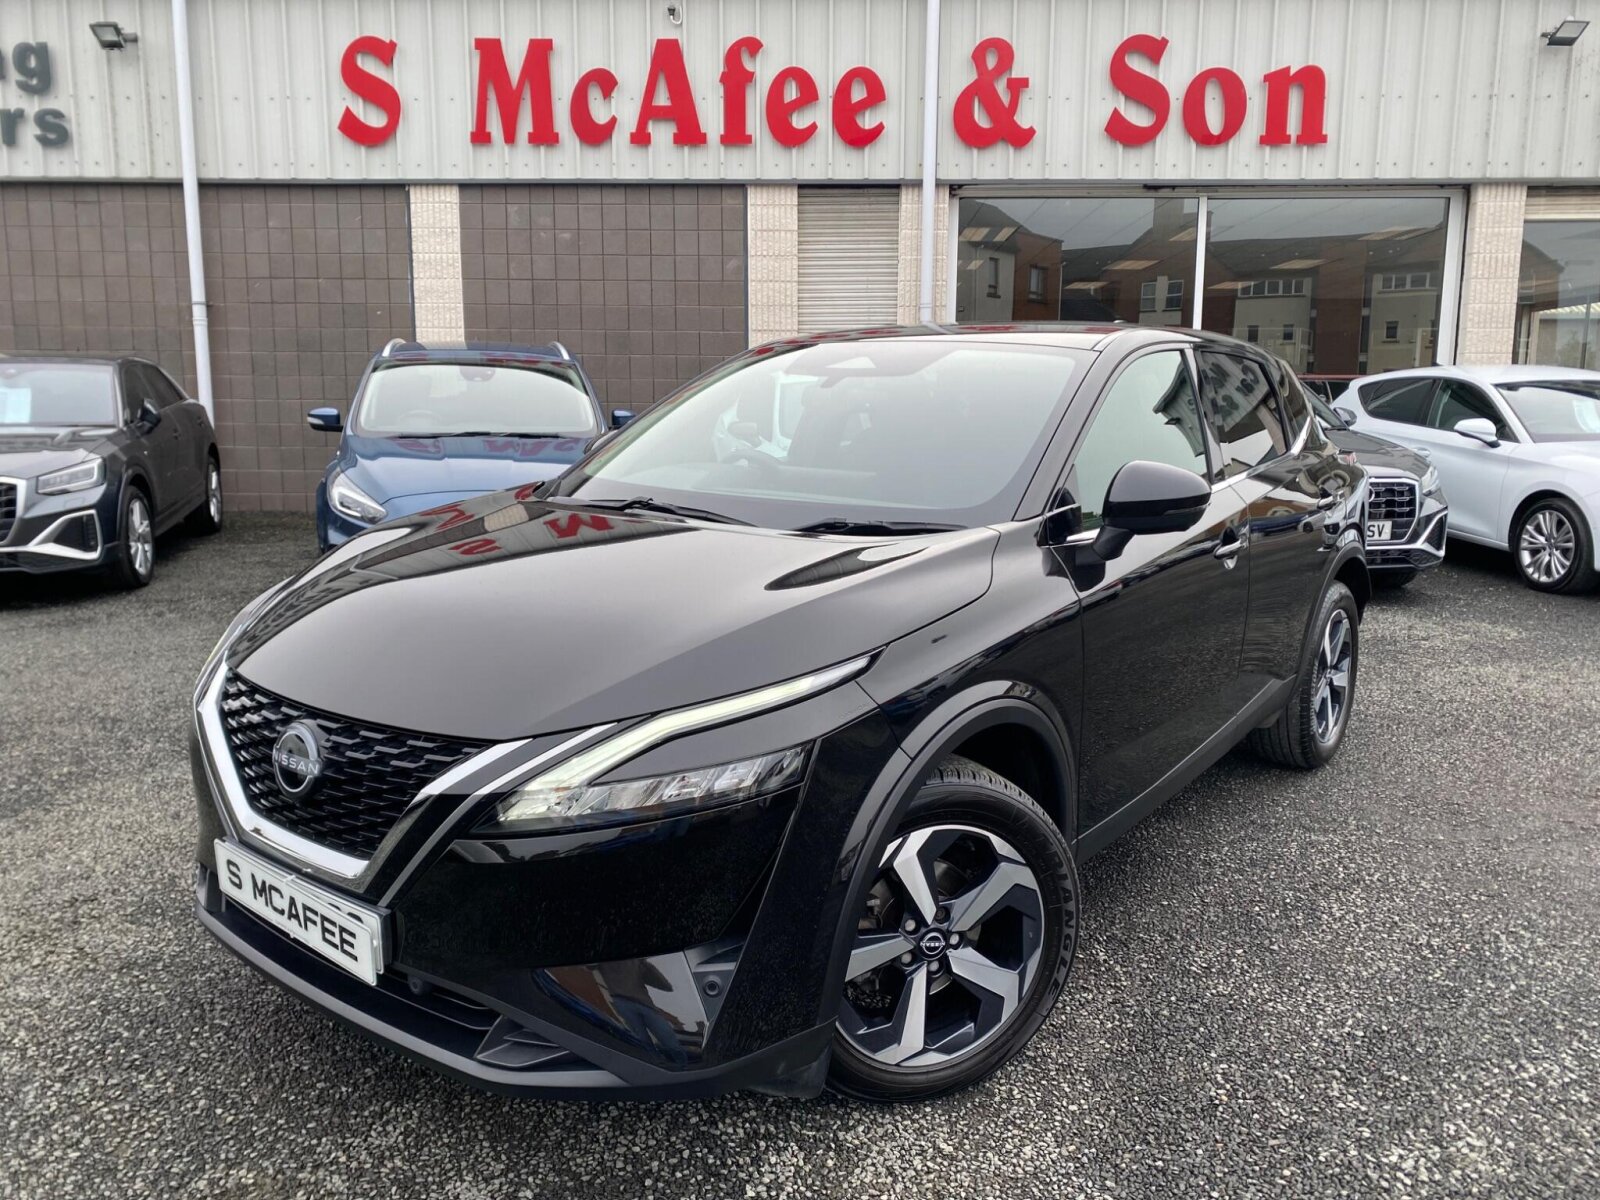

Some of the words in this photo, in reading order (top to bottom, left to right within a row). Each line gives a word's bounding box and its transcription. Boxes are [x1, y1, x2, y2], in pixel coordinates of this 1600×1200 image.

[338, 36, 401, 146] S
[470, 37, 886, 149] McAfee
[953, 37, 1036, 149] &
[1104, 34, 1328, 146] Son
[271, 743, 320, 775] NISSAN
[226, 858, 243, 890] S
[251, 872, 359, 963] MCAFEE
